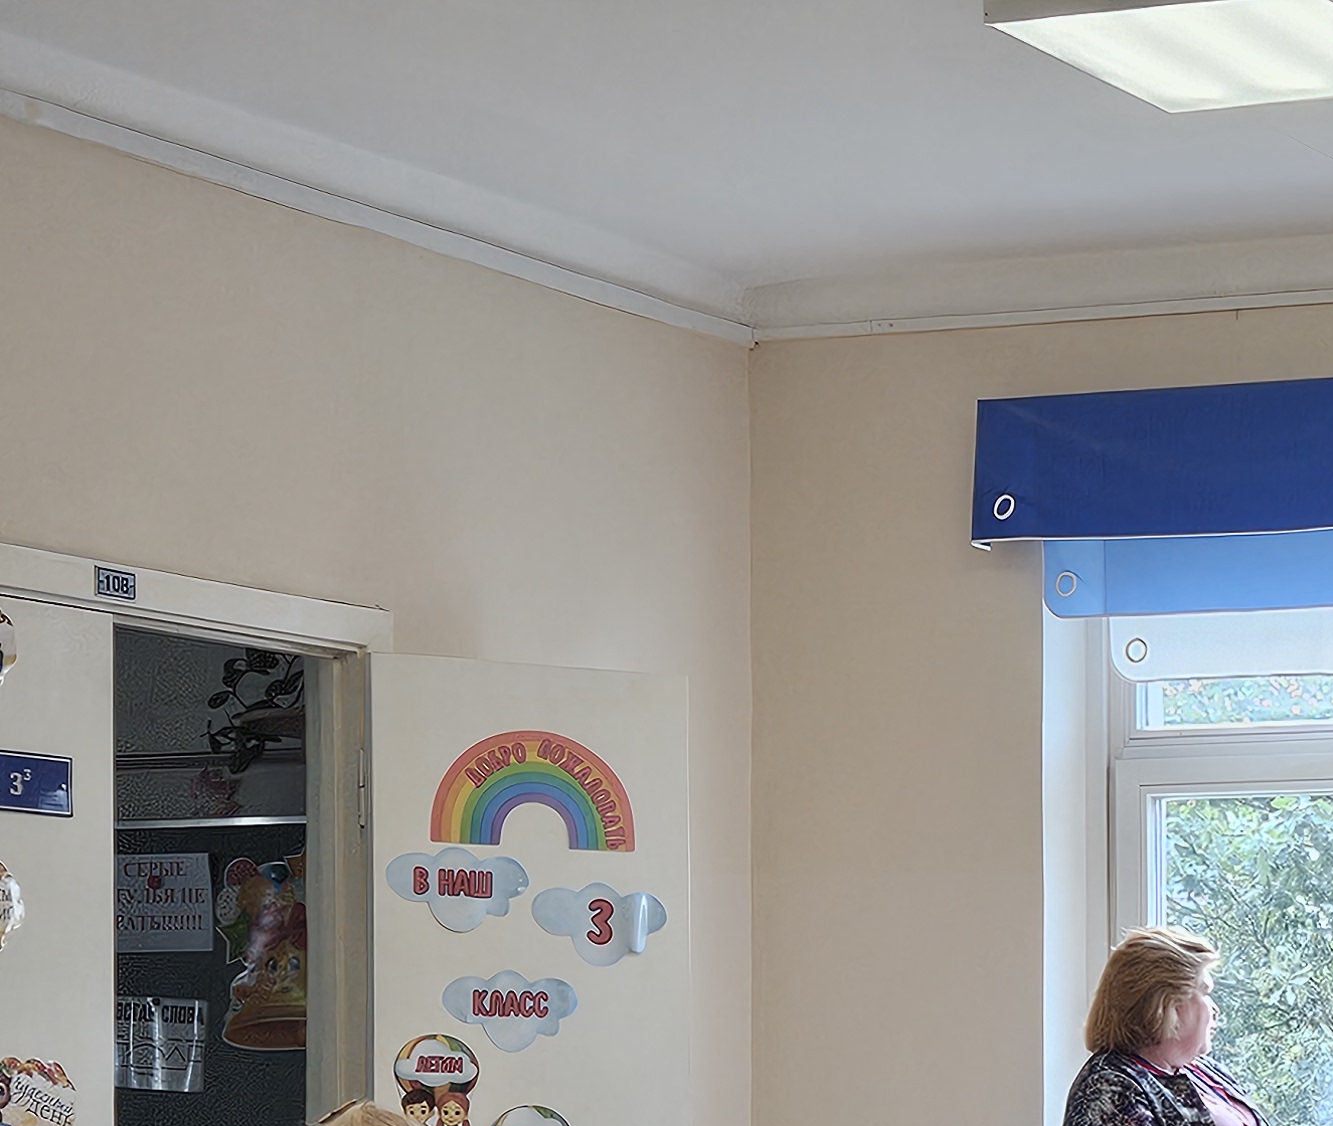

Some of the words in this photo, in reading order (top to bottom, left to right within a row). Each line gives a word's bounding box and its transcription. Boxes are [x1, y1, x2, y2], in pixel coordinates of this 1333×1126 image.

[464, 742, 527, 788] ДОБРО
[413, 866, 429, 895] В
[438, 868, 493, 898] НАШ
[586, 899, 614, 945] 3
[472, 989, 549, 1018] КЛАСС
